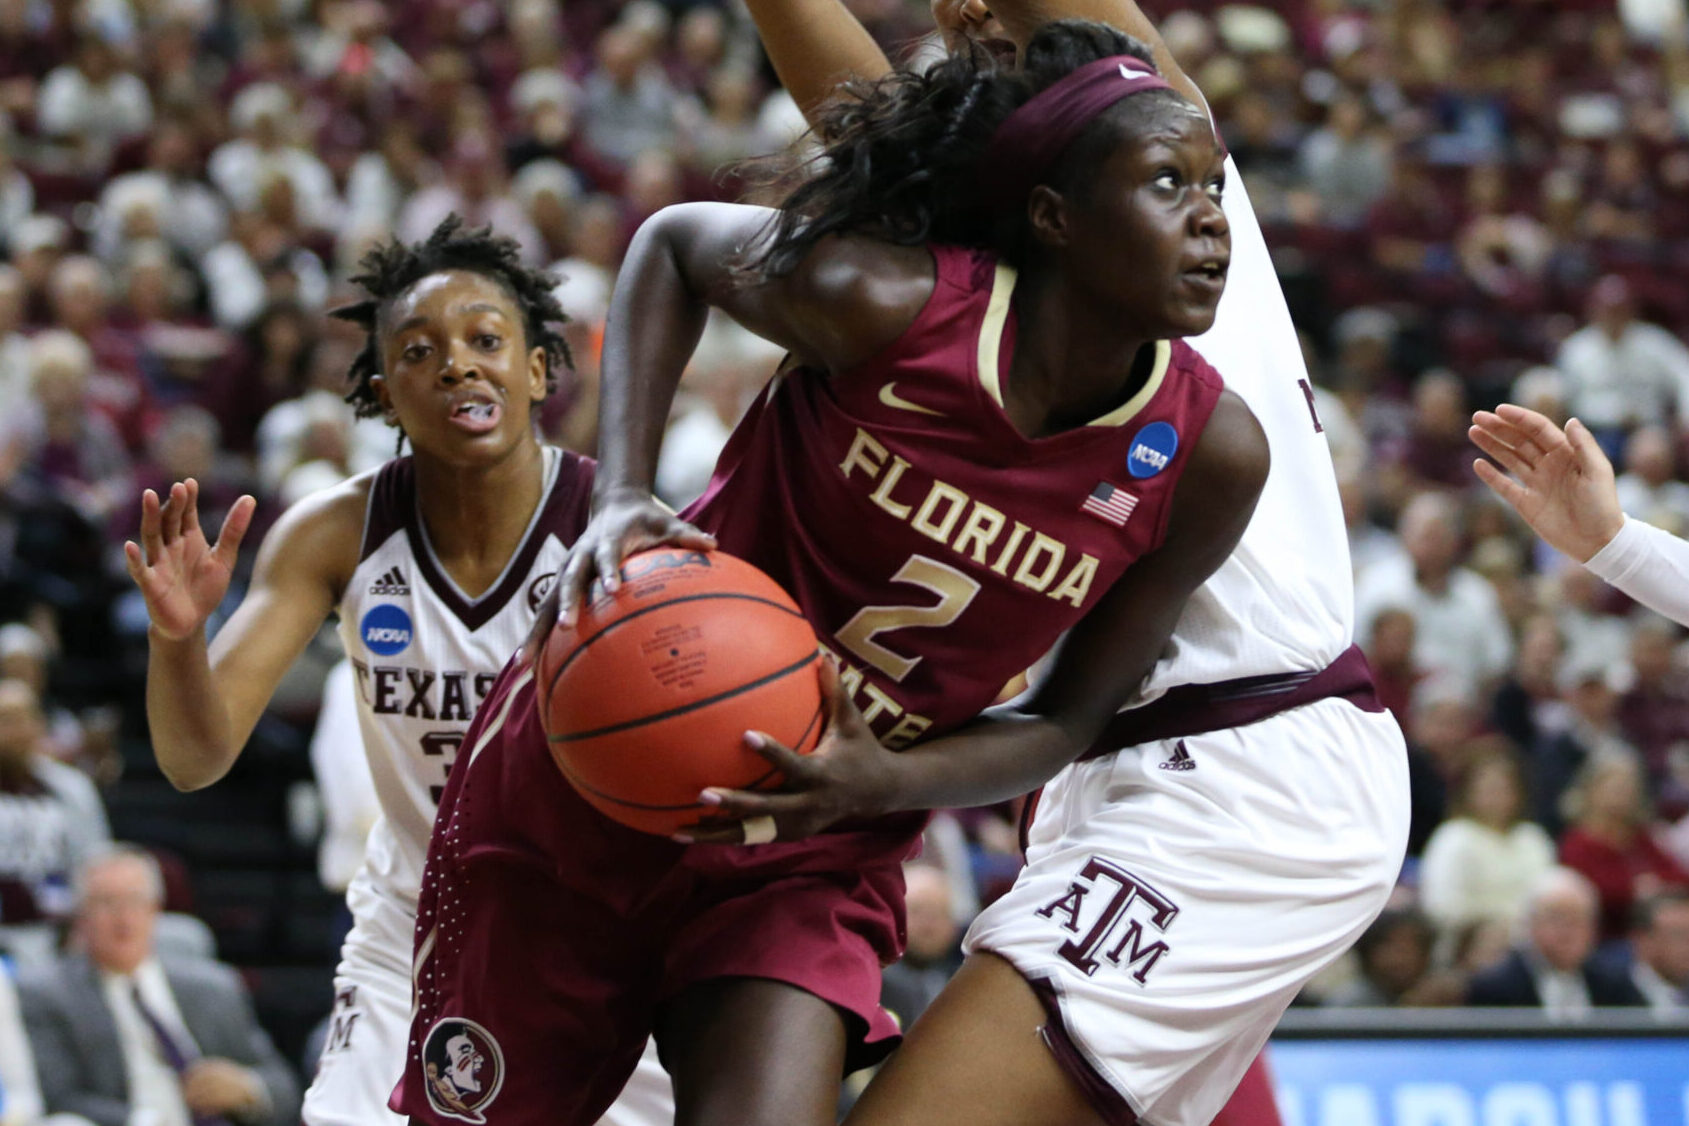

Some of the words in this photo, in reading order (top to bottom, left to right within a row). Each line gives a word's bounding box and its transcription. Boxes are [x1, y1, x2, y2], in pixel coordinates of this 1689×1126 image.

[1131, 443, 1169, 471] NCAA
[838, 427, 1100, 608] FLORIDA
[368, 585, 411, 596] adidas
[833, 553, 982, 683] 2
[366, 626, 410, 644] NCAA
[818, 640, 934, 750] ATE
